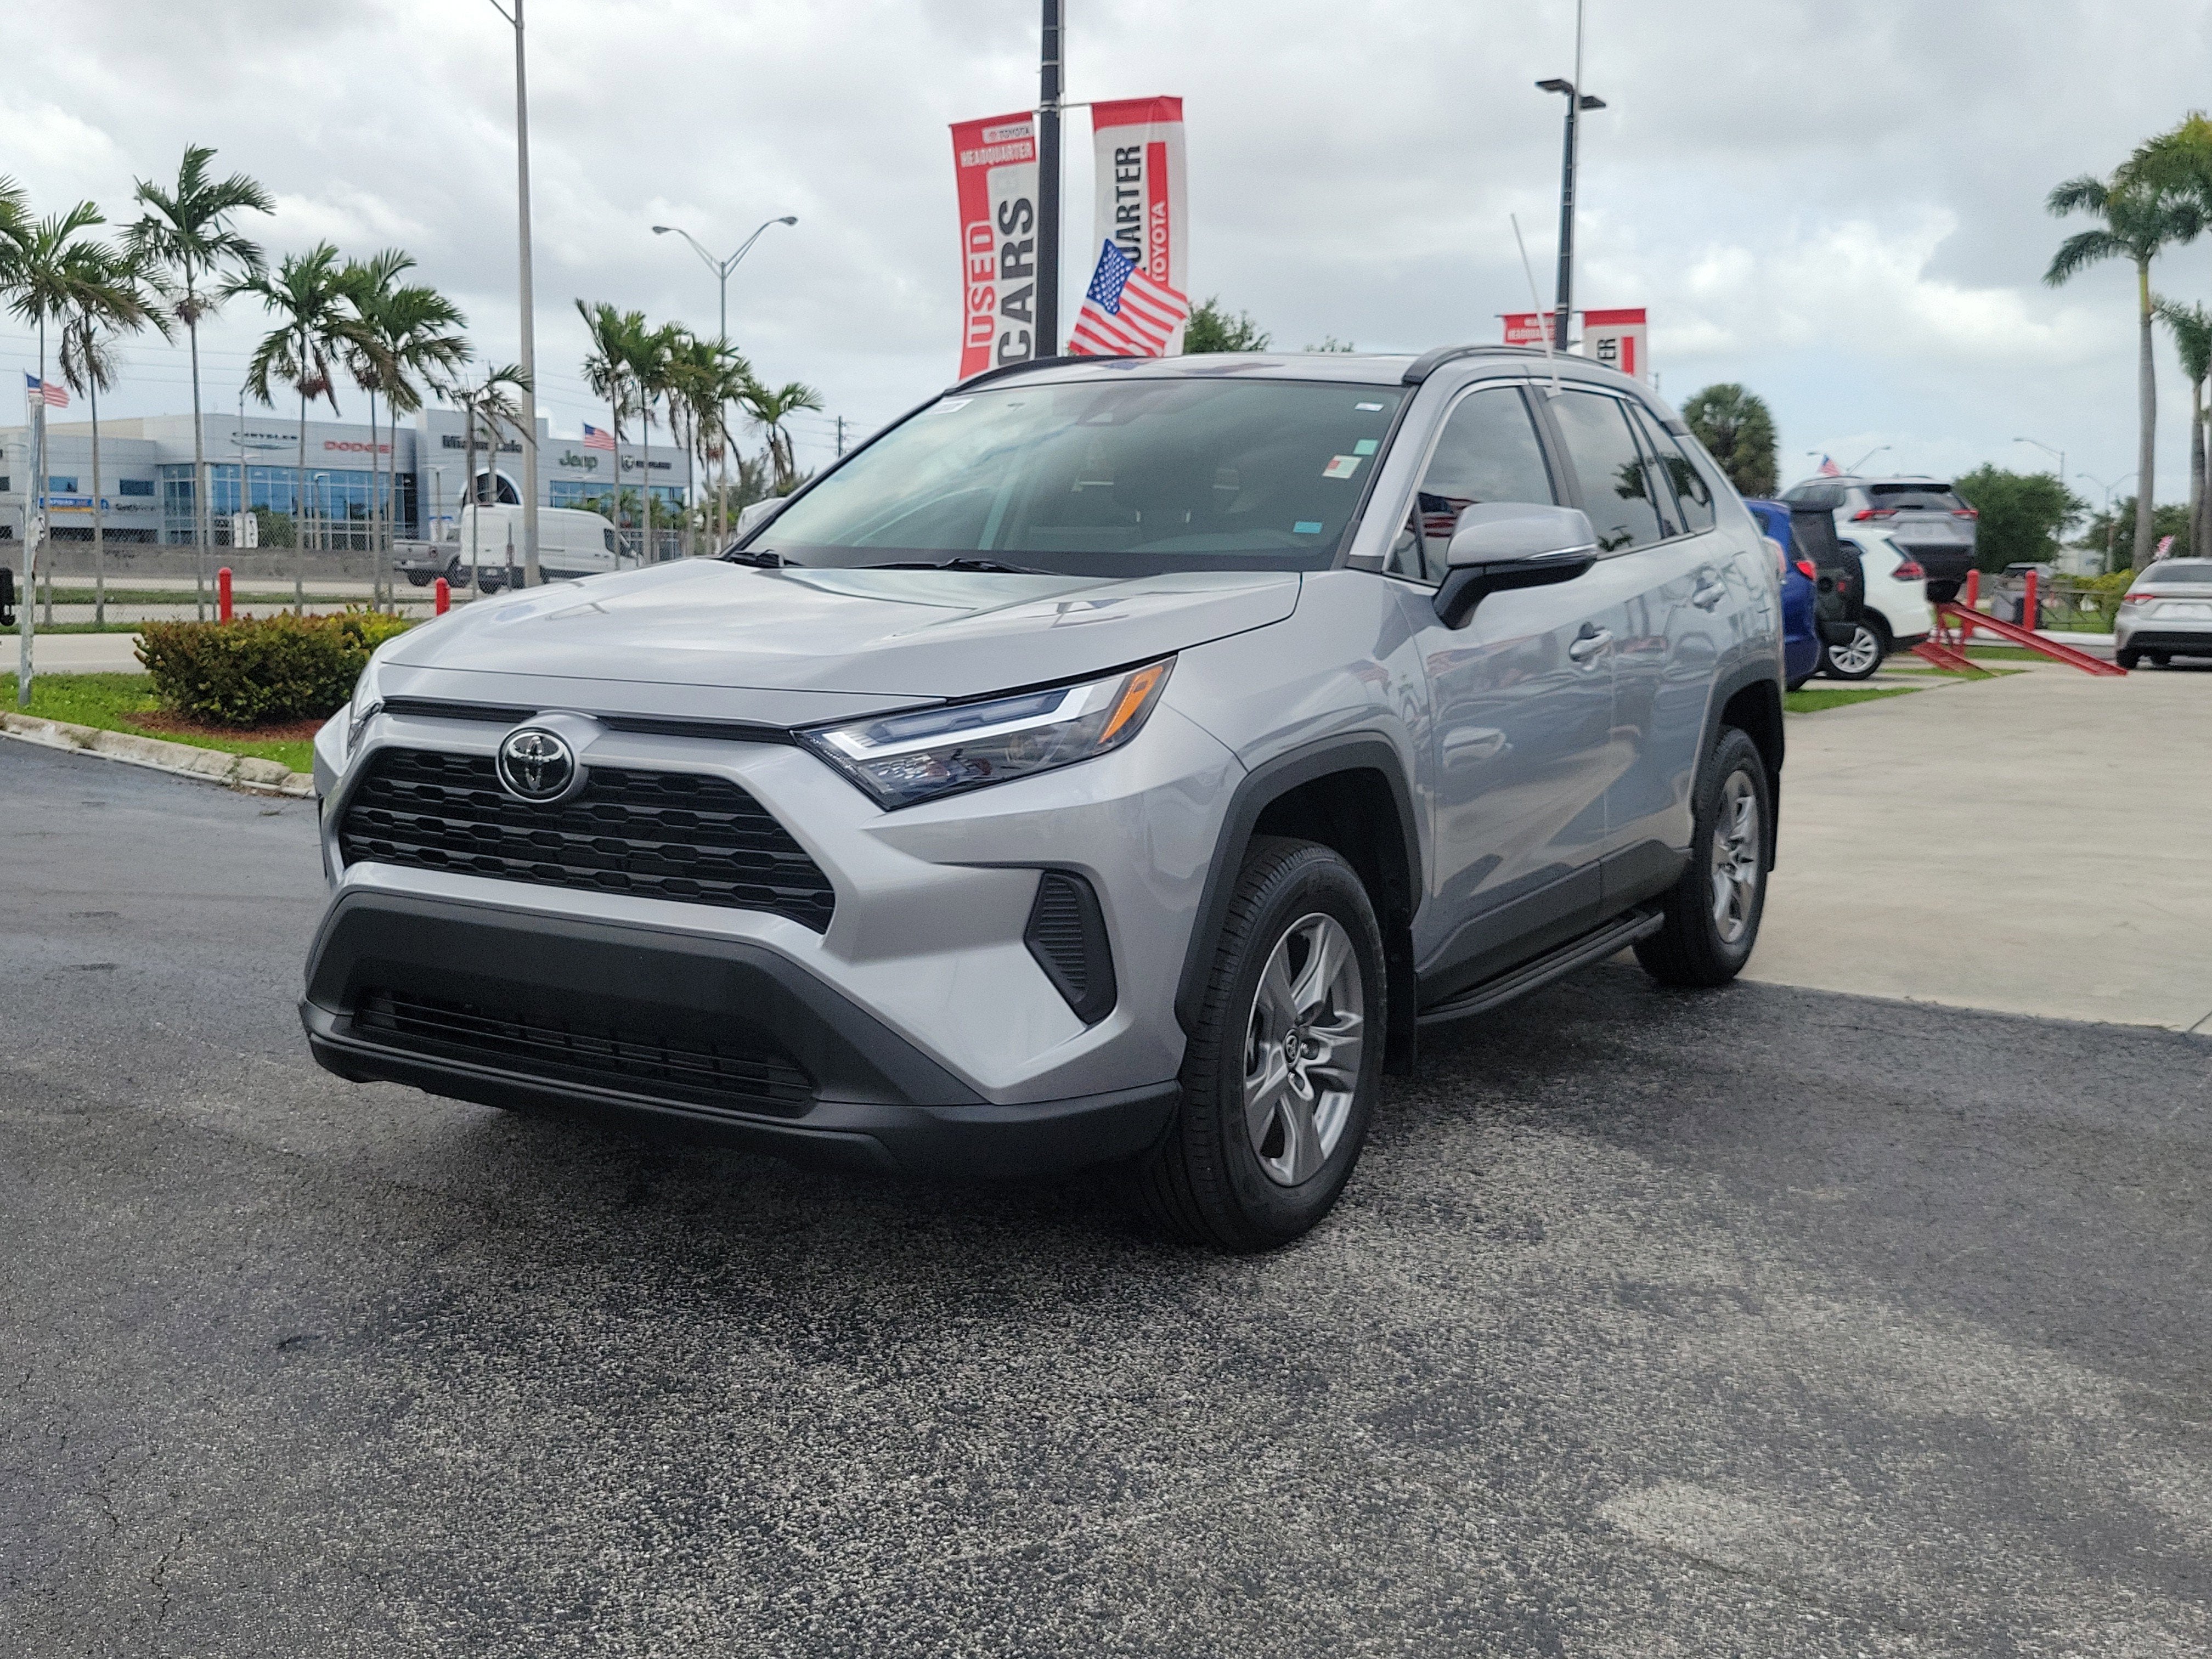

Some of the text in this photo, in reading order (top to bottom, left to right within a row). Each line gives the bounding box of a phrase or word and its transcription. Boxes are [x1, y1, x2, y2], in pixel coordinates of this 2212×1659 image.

[1115, 145, 1142, 264] UARTER
[1151, 201, 1167, 283] TOYOTA
[970, 224, 995, 343] USED
[997, 198, 1034, 366] CARS
